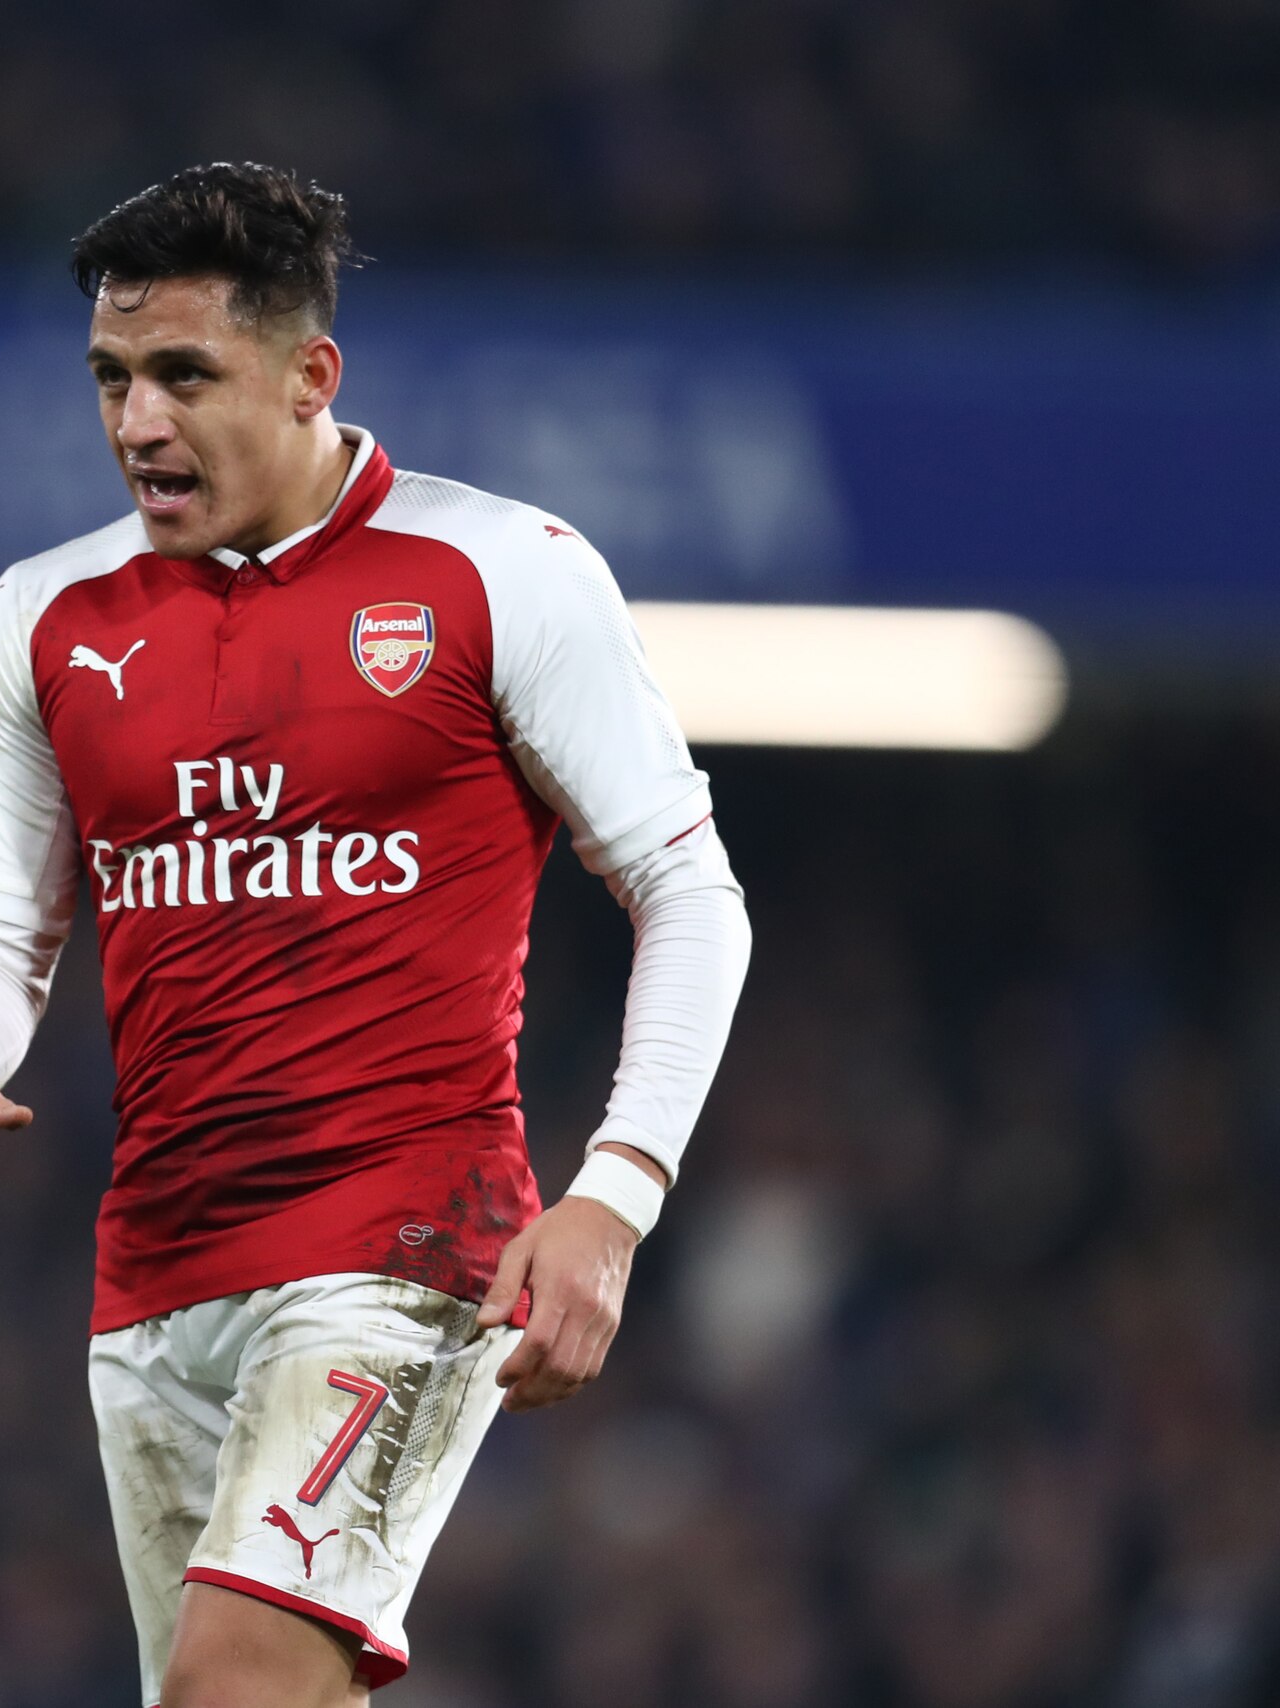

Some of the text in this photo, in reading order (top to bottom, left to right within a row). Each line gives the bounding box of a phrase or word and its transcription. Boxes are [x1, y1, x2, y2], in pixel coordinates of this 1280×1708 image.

[361, 616, 423, 633] Arsenal
[173, 757, 284, 820] Fly
[87, 820, 421, 912] Emirates
[296, 1369, 389, 1506] 7
